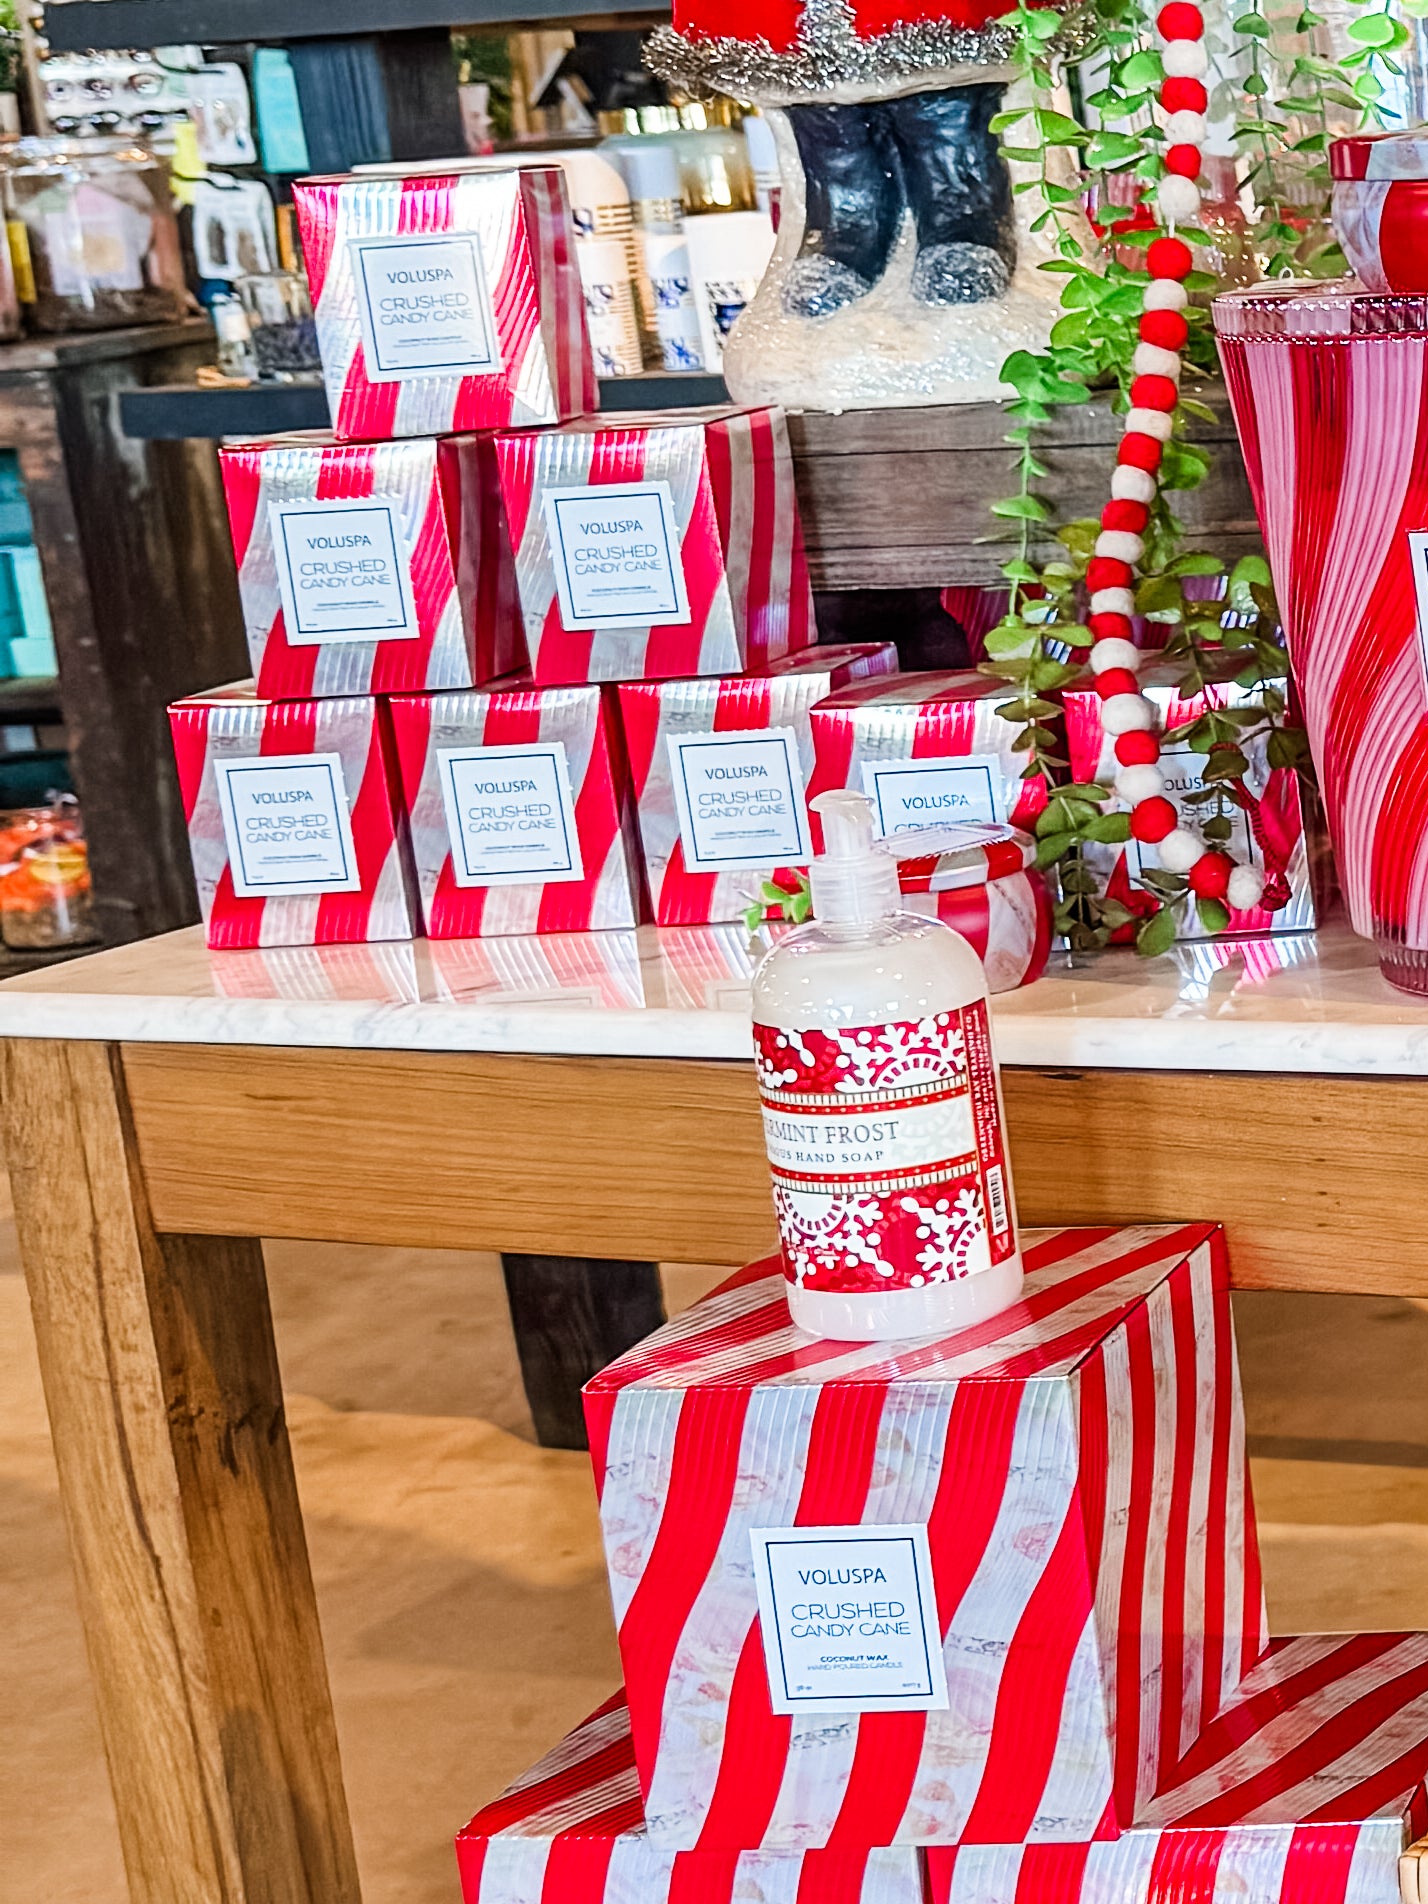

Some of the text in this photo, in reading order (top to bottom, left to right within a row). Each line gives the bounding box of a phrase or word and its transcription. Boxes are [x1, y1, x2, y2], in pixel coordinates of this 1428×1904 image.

[387, 269, 454, 283] VOLUSPA
[380, 293, 469, 311] CRUSHED
[380, 309, 473, 325] CANDY CANE
[580, 520, 643, 534] VOLUSPA
[307, 535, 372, 549] VOLUSPA
[575, 544, 657, 561] CRUSHED
[301, 559, 386, 576] CRUSHED
[575, 560, 662, 575] CANDY CANE
[301, 574, 391, 589] CANDY CANE
[705, 766, 768, 779] VOLUSPA
[475, 780, 537, 794] VOLUSPA
[1164, 777, 1207, 791] OLUS
[252, 791, 314, 804] VOLUSPA
[699, 789, 782, 805] CRUSHED
[902, 795, 970, 809] VOLUSPA
[469, 804, 551, 820] CRUSHED
[699, 804, 787, 818] CANDY CANE
[246, 814, 328, 830] CRUSHED
[469, 818, 556, 833] CANDY CANE
[247, 829, 332, 843] CANDY CANE
[826, 1121, 899, 1144] FROST
[796, 1151, 883, 1163] HAND SOAP
[798, 1568, 887, 1585] VOLUSPA
[791, 1601, 904, 1620] CRUSHED
[791, 1621, 911, 1638] CANDY CANE
